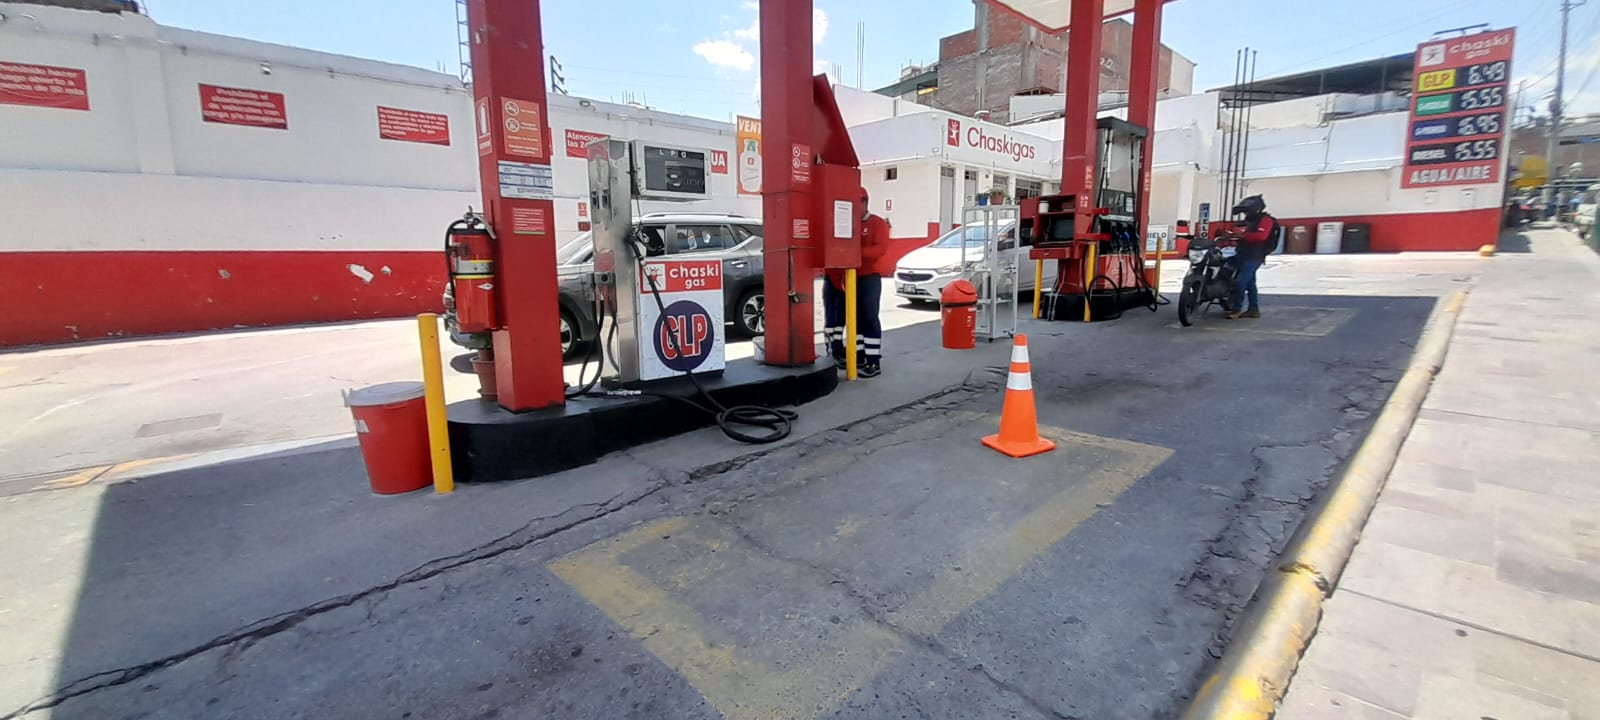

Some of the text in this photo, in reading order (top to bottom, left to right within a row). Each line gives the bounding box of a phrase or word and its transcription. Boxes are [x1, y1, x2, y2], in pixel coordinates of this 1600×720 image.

[1448, 34, 1511, 54] chaski
[1423, 73, 1450, 89] GLP
[738, 117, 761, 135] VENT
[967, 126, 1035, 162] Chaskigas
[711, 152, 726, 167] UA
[669, 263, 720, 278] chaski
[685, 279, 706, 289] gas
[660, 313, 708, 360] GLP
